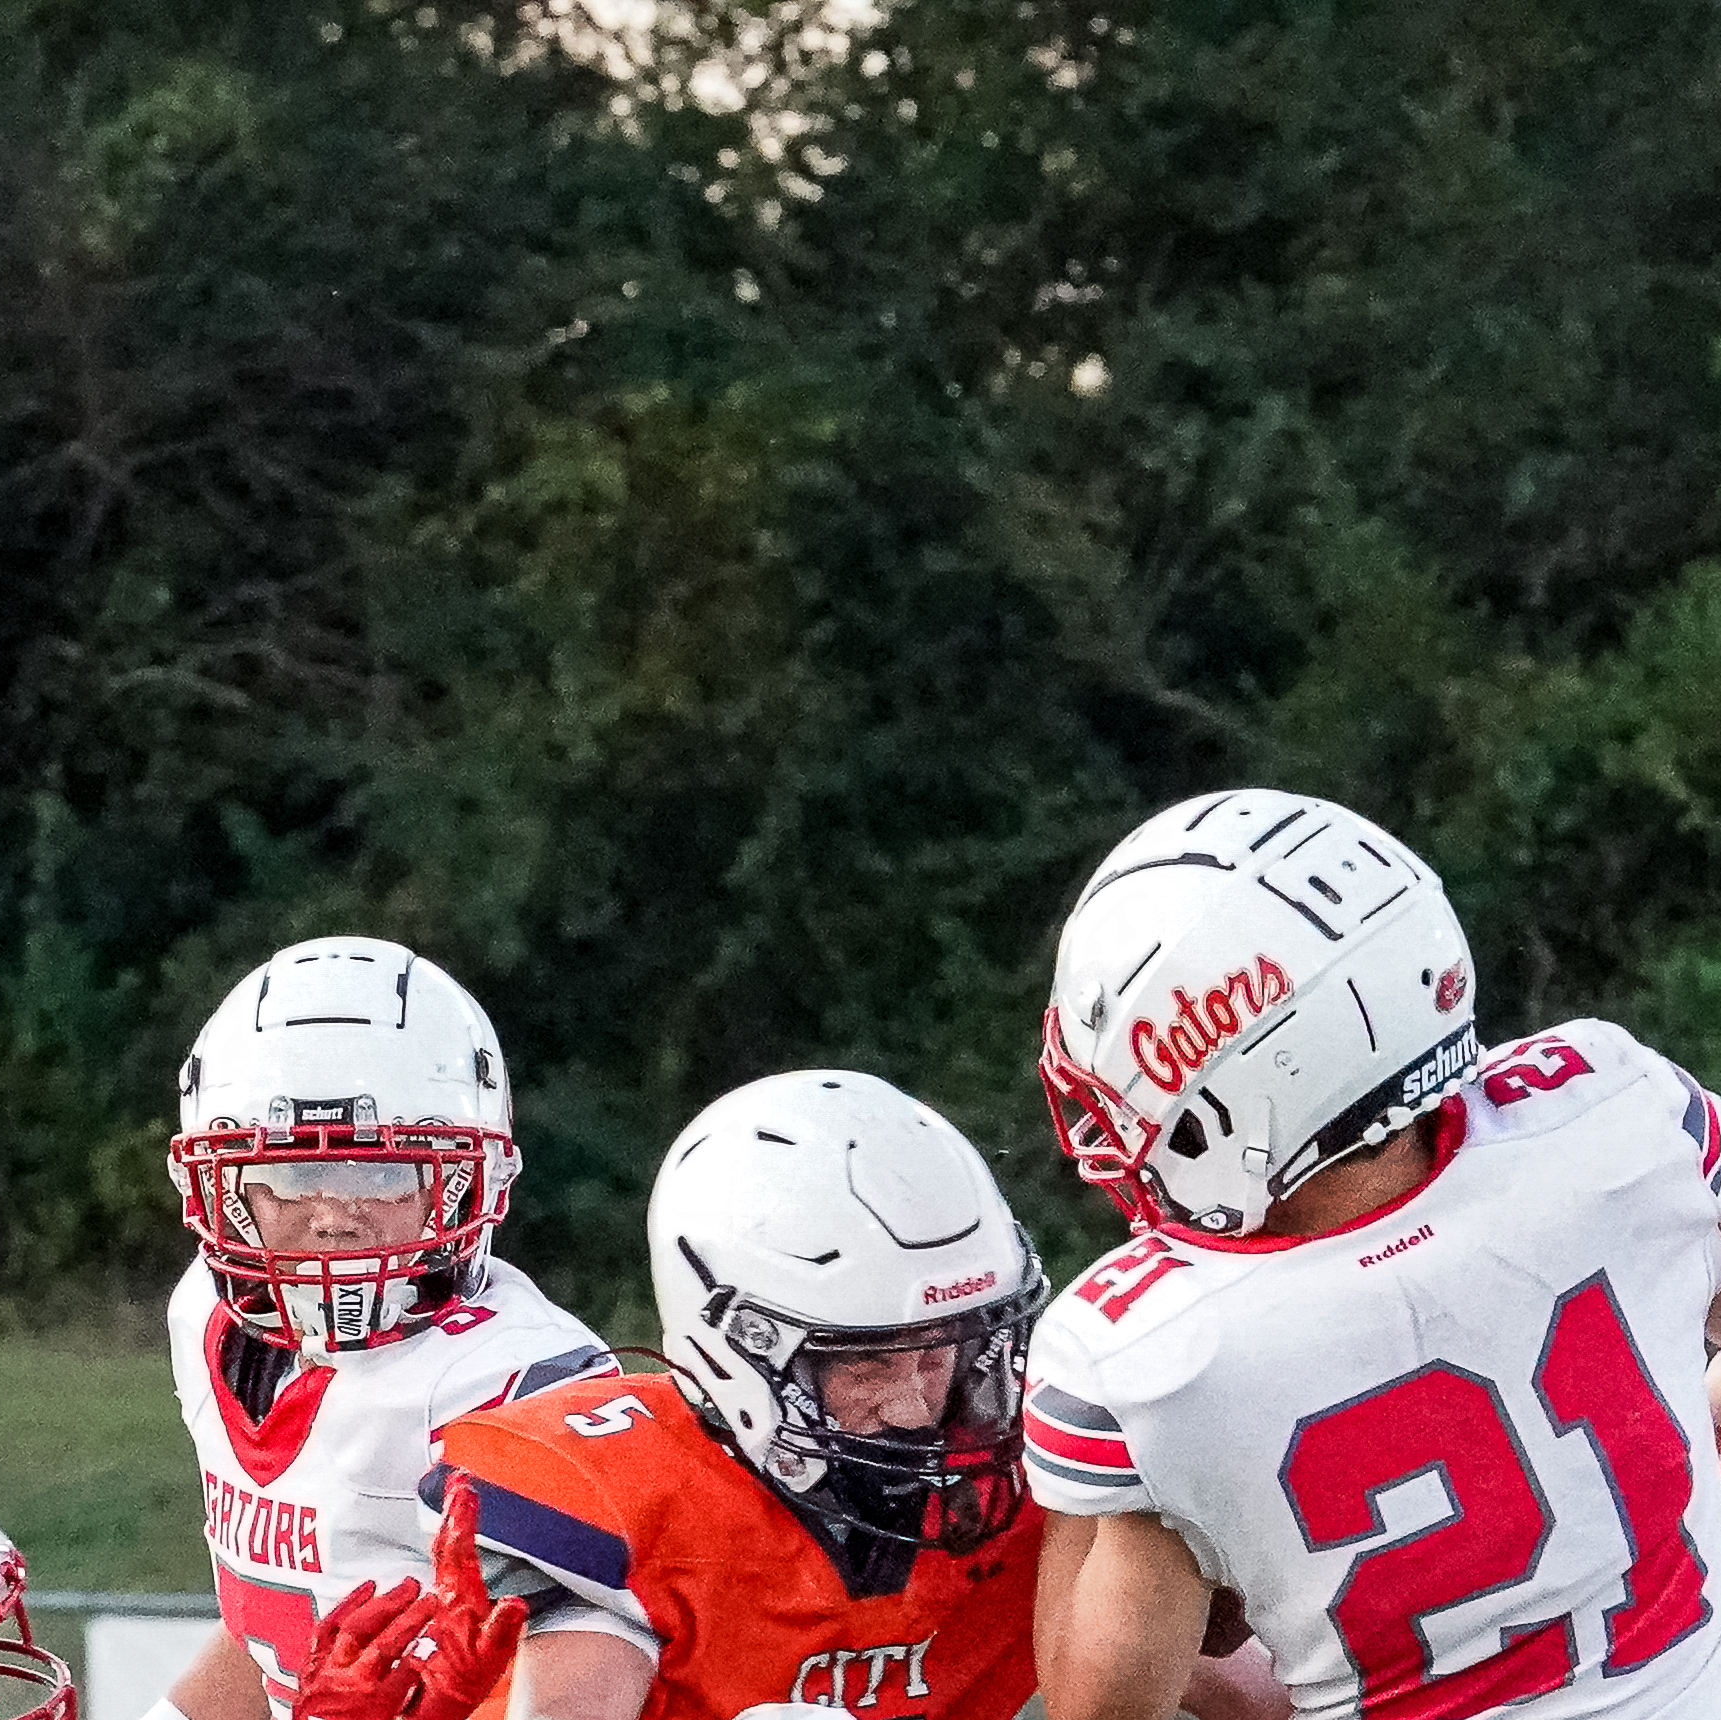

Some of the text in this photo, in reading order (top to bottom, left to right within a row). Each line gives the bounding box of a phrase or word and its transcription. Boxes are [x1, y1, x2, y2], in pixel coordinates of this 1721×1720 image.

[1130, 954, 1294, 1096] Gators
[1357, 1224, 1435, 1268] Riddell
[923, 1271, 997, 1305] Riddell
[563, 1393, 656, 1438] 5
[205, 1469, 323, 1574] GATORS
